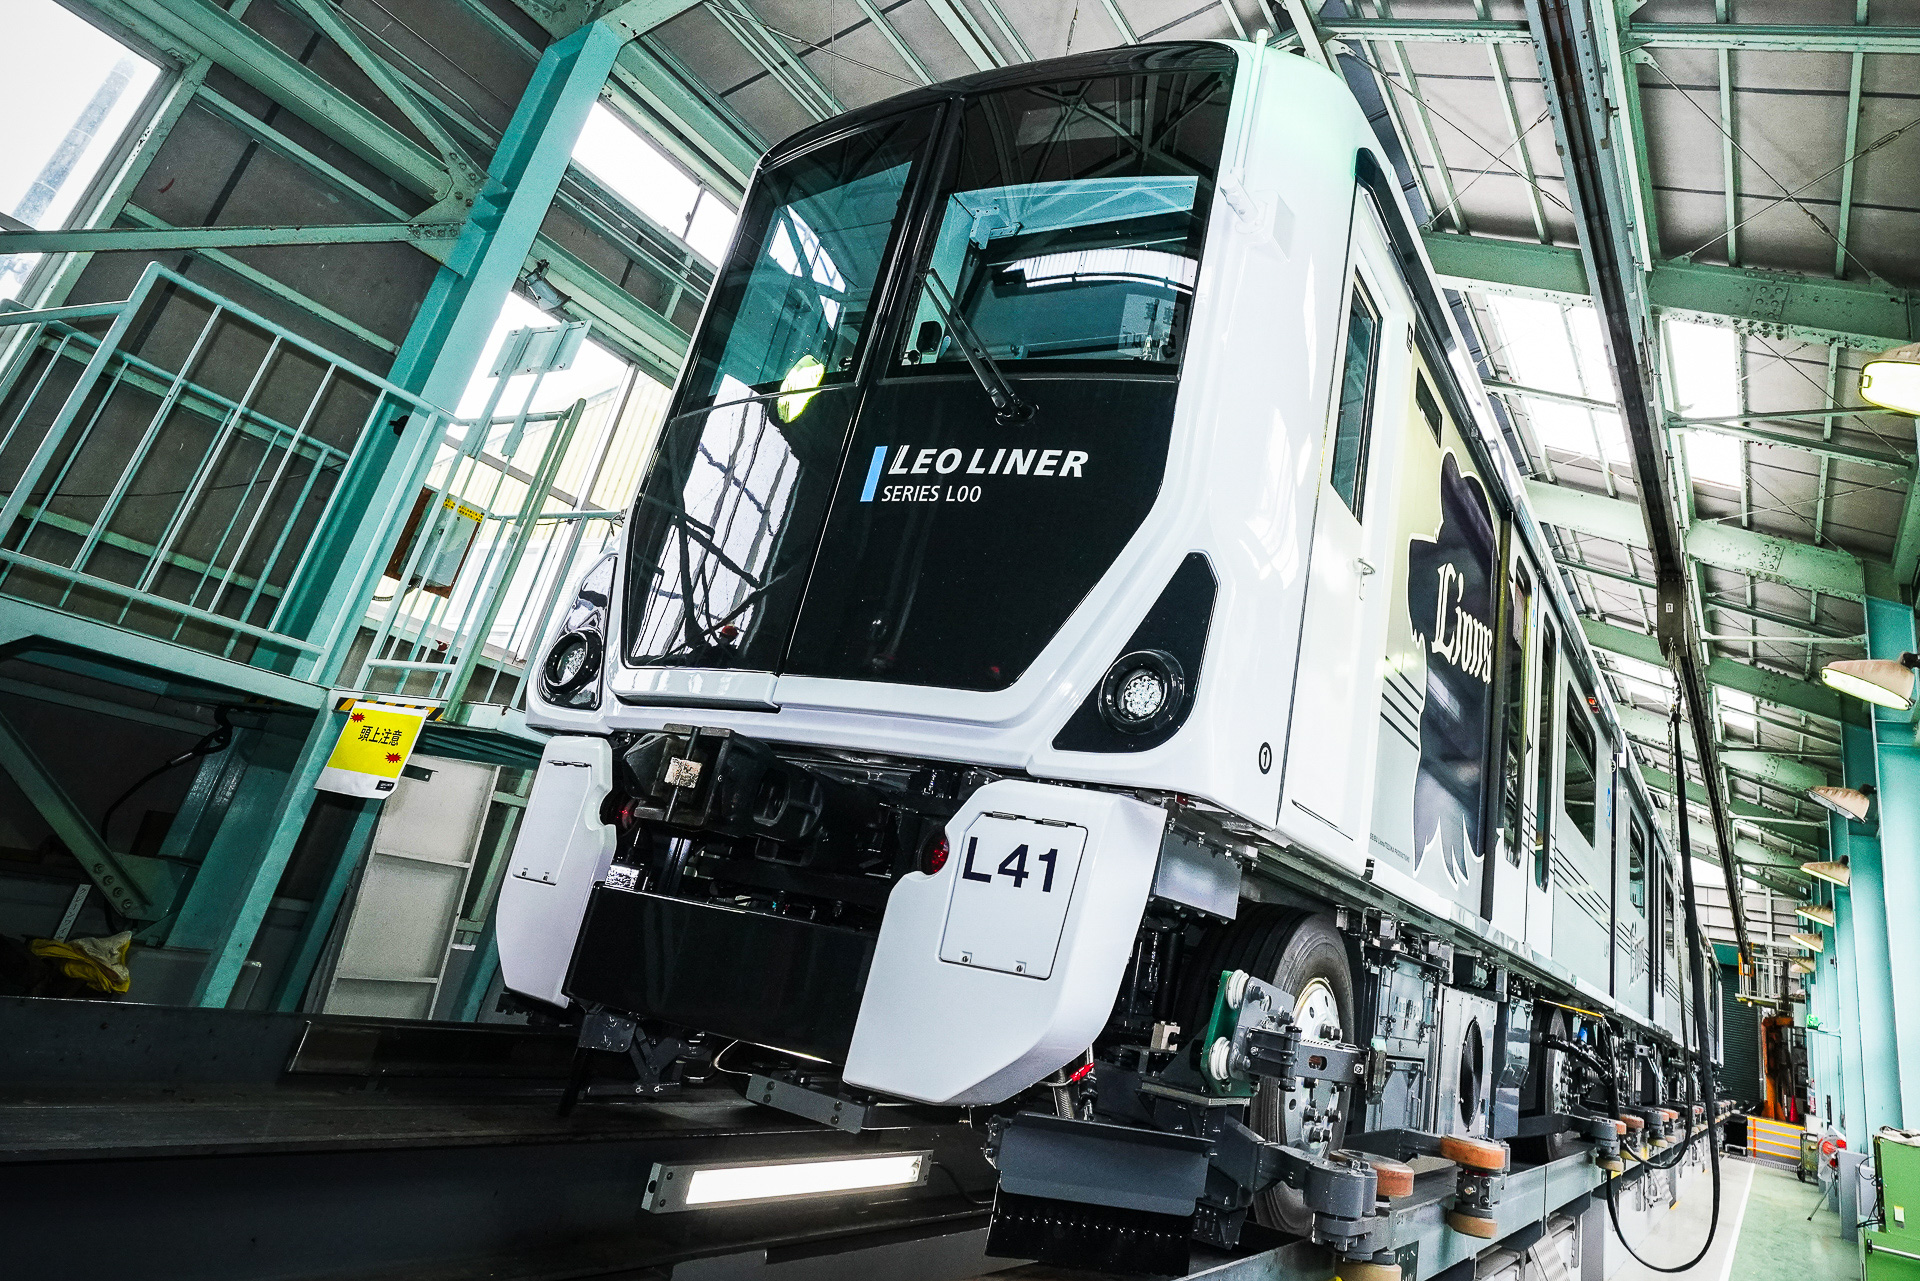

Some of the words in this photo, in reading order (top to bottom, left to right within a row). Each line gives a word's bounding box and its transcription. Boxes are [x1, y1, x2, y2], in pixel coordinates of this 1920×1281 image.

[888, 445, 963, 475] LEO
[965, 447, 1090, 478] LINER
[881, 485, 941, 502] SERIES
[1431, 562, 1493, 685] Lions
[358, 725, 403, 747] 頭上注意
[962, 836, 1059, 893] L41
